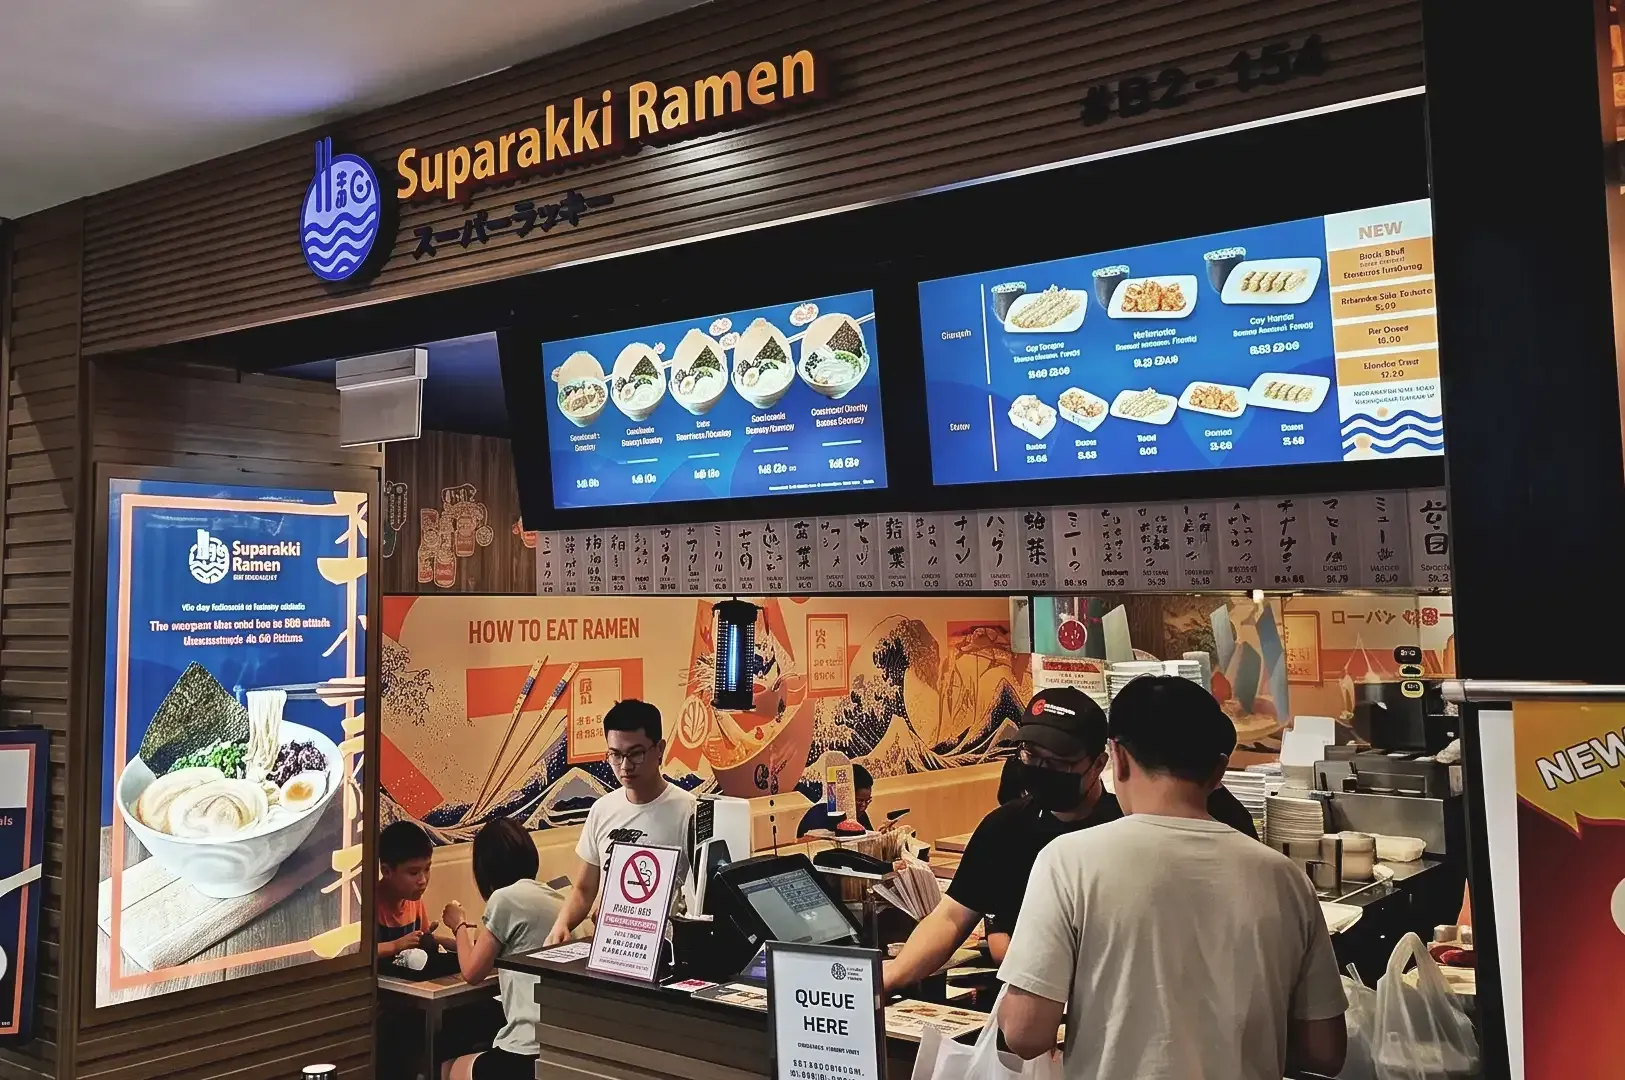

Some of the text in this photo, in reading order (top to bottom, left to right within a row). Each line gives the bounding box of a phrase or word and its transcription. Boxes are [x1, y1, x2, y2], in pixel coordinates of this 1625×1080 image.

[397, 90, 613, 199] Suparakki
[629, 49, 816, 138] Ramen
[1359, 221, 1402, 239] NEW
[232, 540, 301, 557] Suparakki
[232, 557, 281, 572] Ramen
[469, 617, 640, 644] HOW TO EAT RAMEN
[795, 989, 855, 1010] QUEUE
[803, 1015, 849, 1036] HERE
